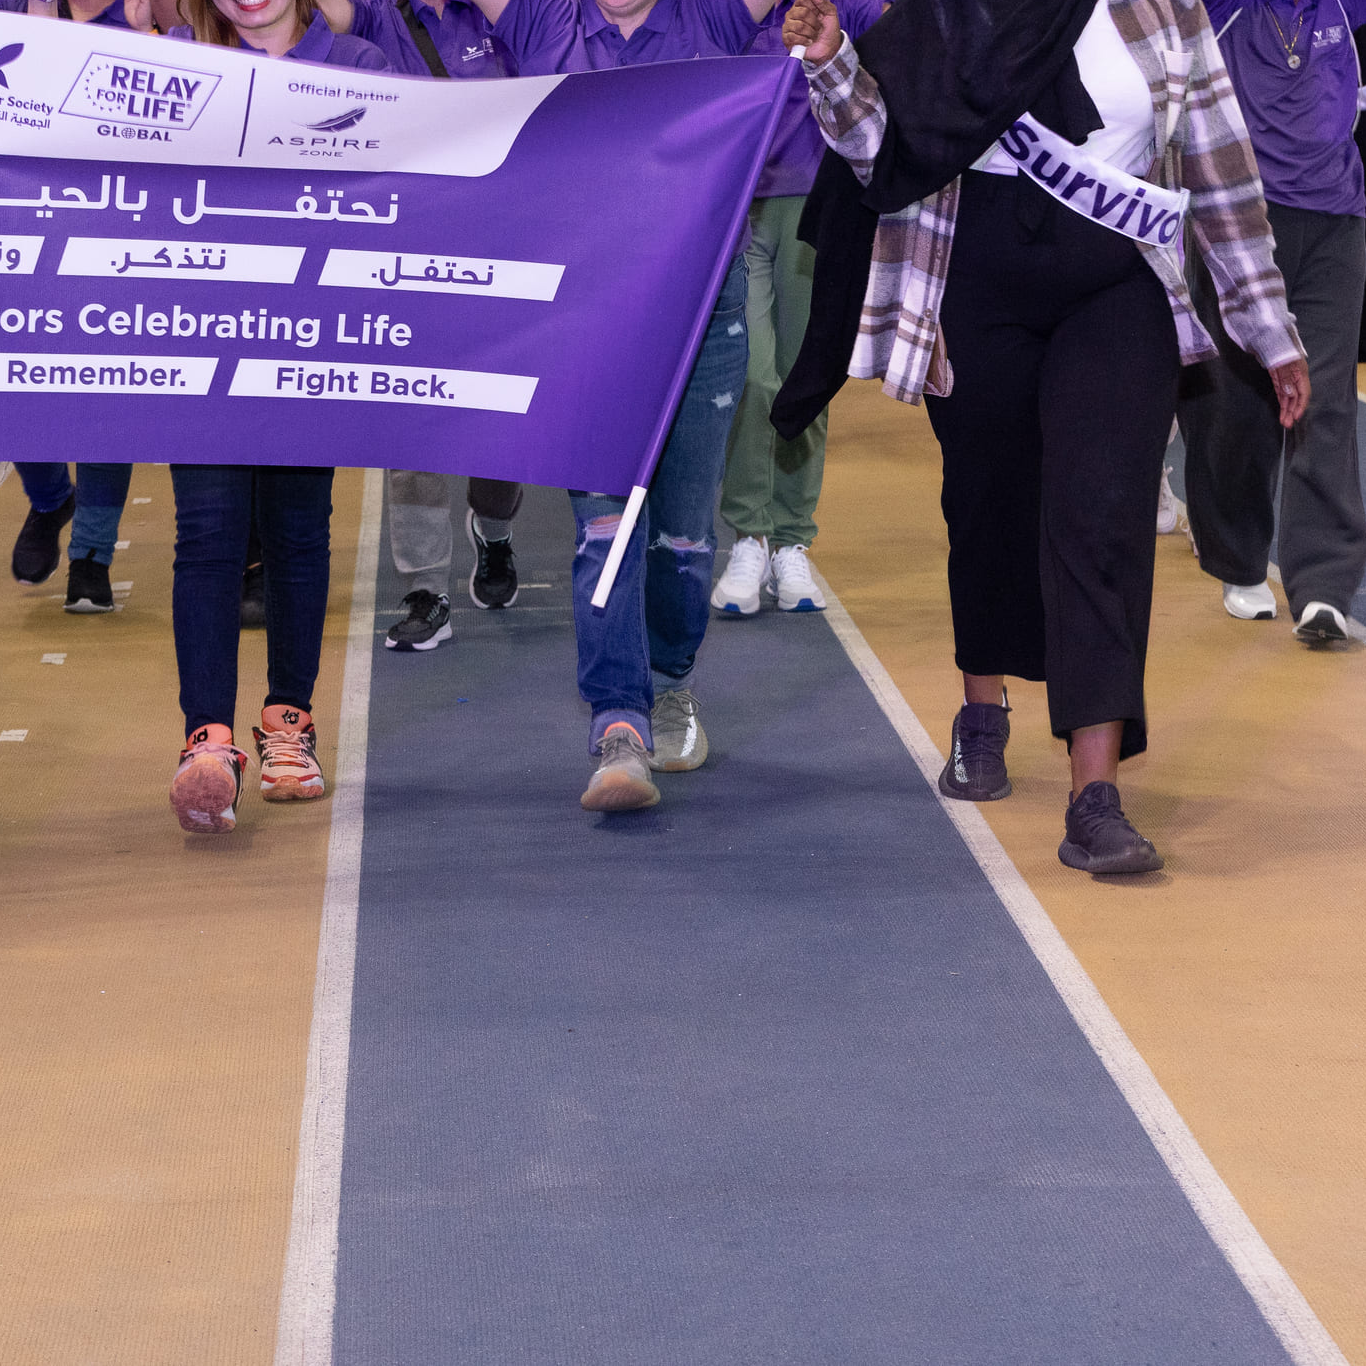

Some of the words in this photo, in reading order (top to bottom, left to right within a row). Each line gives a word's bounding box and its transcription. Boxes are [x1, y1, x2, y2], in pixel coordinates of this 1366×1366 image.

[110, 65, 202, 101] RELAY
[288, 83, 340, 97] Official
[346, 90, 399, 101] Partner
[8, 96, 54, 116] Society
[11, 111, 50, 130] الجمعية
[96, 89, 126, 104] FOR
[127, 95, 185, 123] LIFE
[79, 304, 320, 347] Celebrating
[337, 314, 411, 346] Life
[8, 360, 185, 386] Remember.
[277, 367, 358, 396] Fight
[371, 372, 454, 399] Back.
